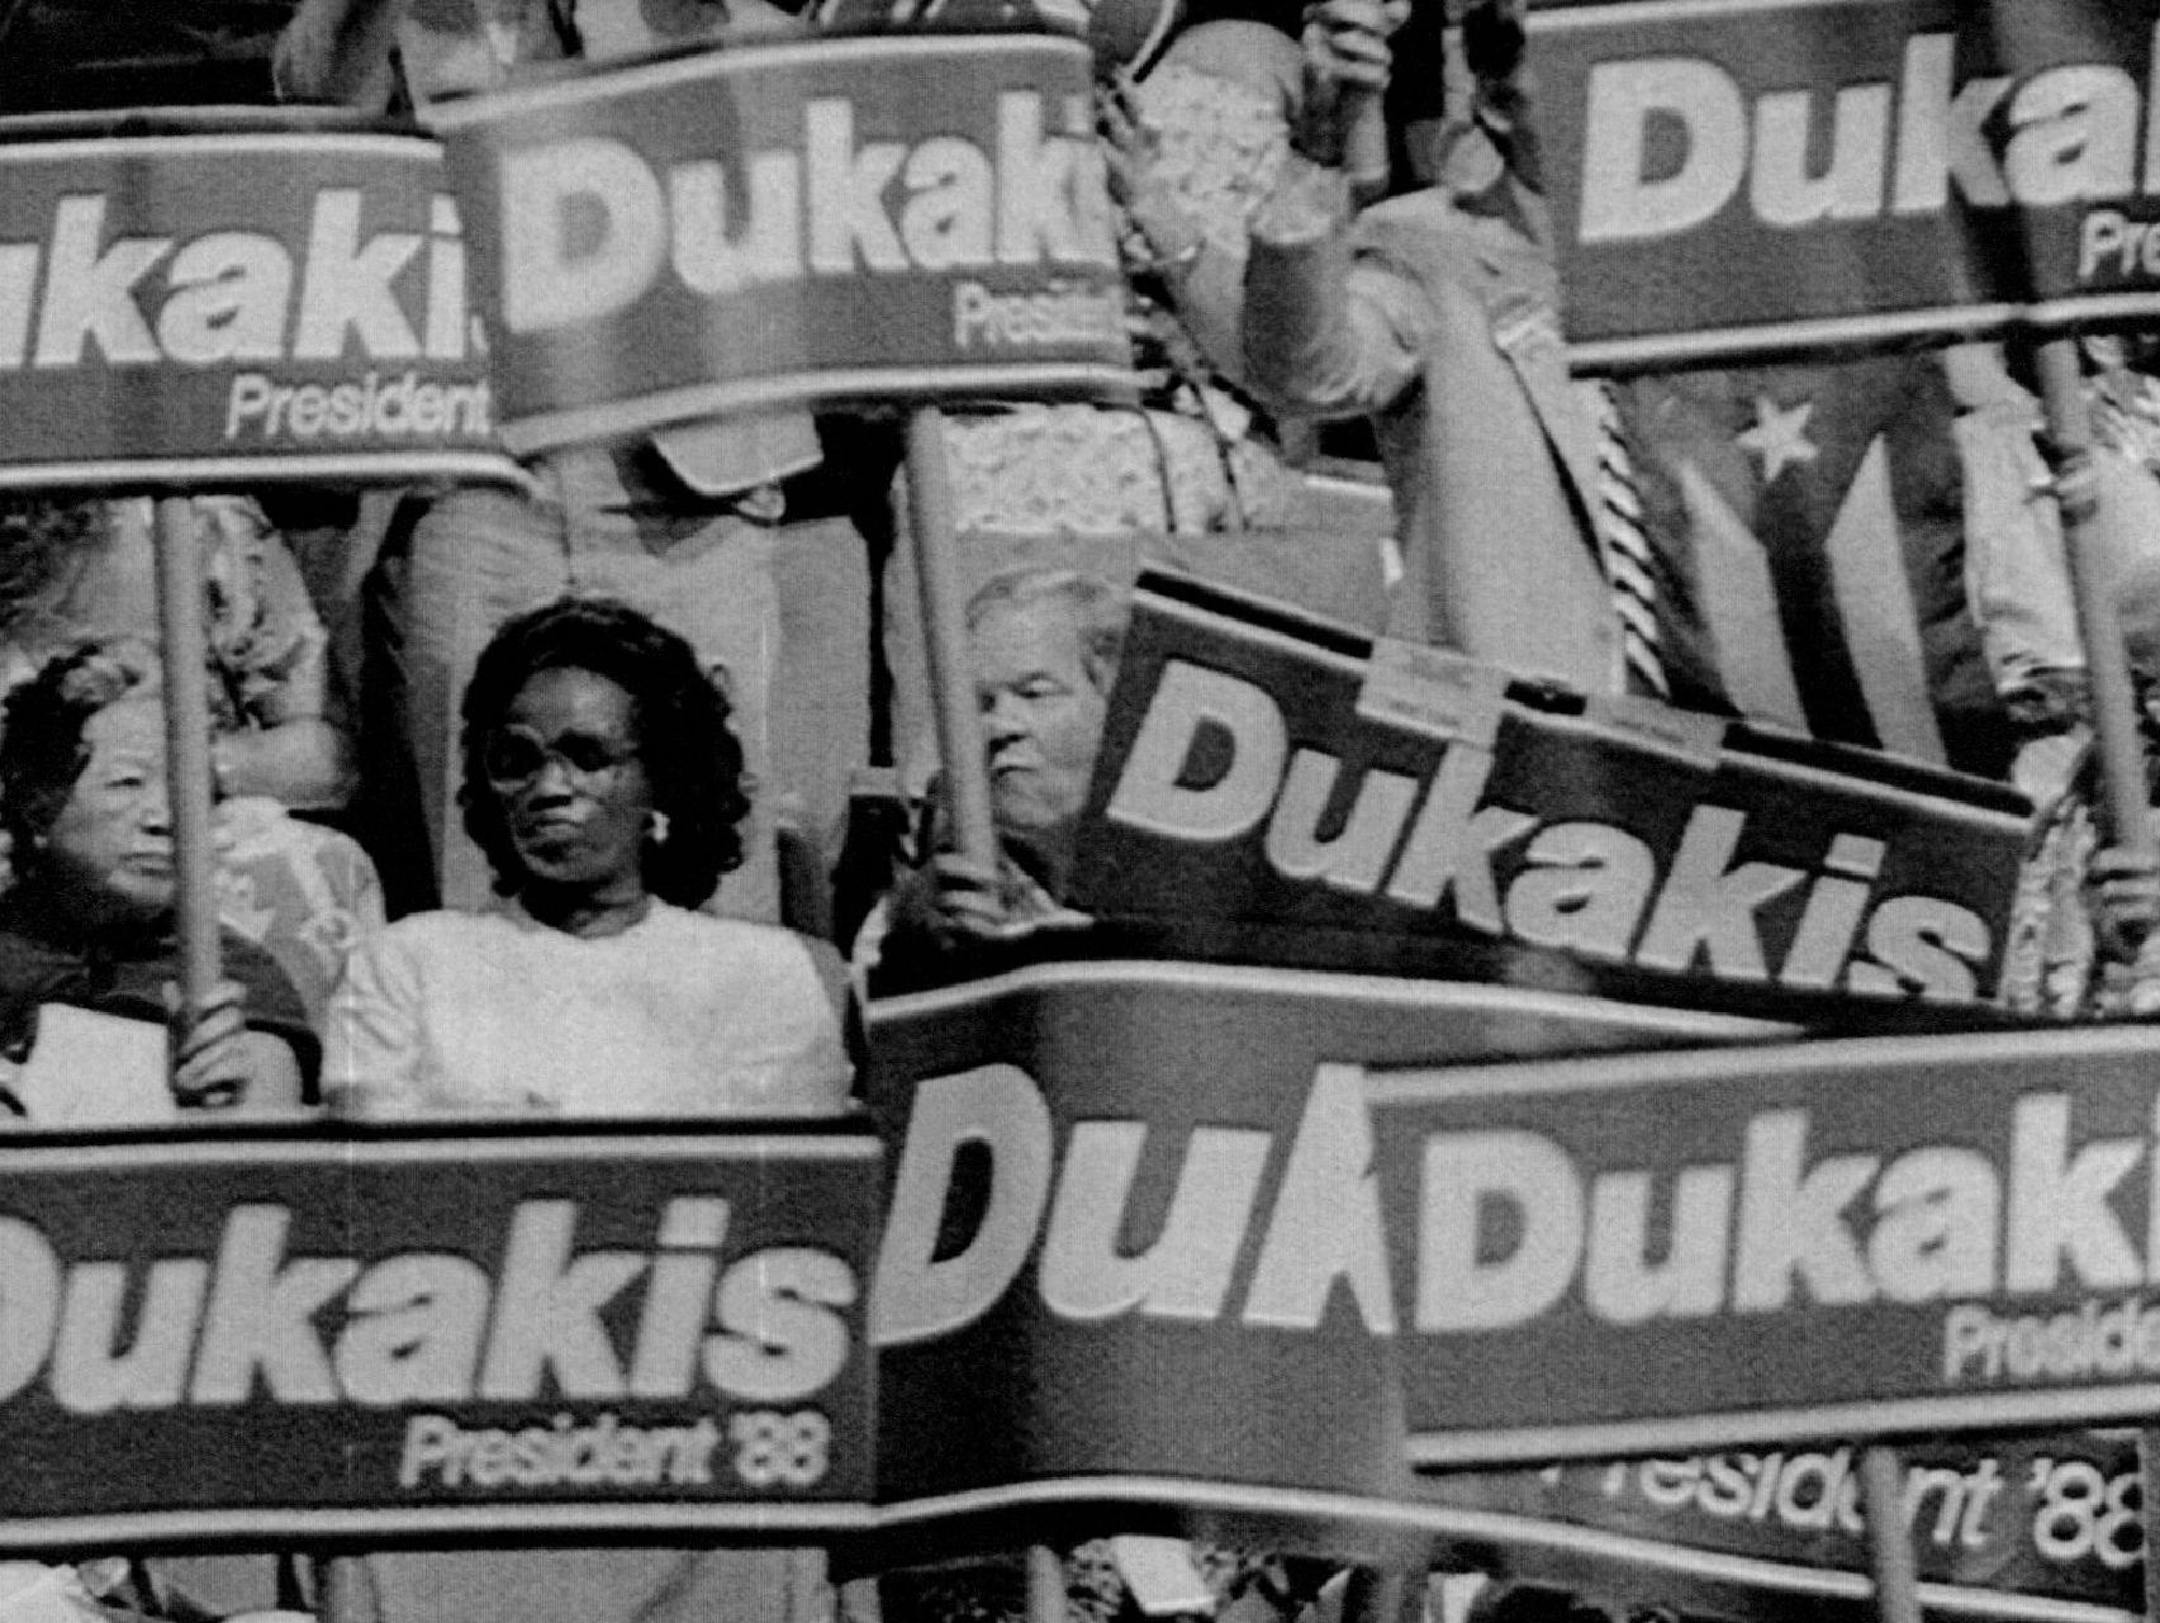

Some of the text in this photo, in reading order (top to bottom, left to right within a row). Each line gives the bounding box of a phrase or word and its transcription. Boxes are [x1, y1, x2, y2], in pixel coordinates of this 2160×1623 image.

[1578, 17, 2160, 245] Duka
[0, 188, 489, 371] kaki
[1106, 658, 1992, 1002] Dukakis
[1414, 1092, 2160, 1334] Dukak
[400, 1412, 722, 1489] President
